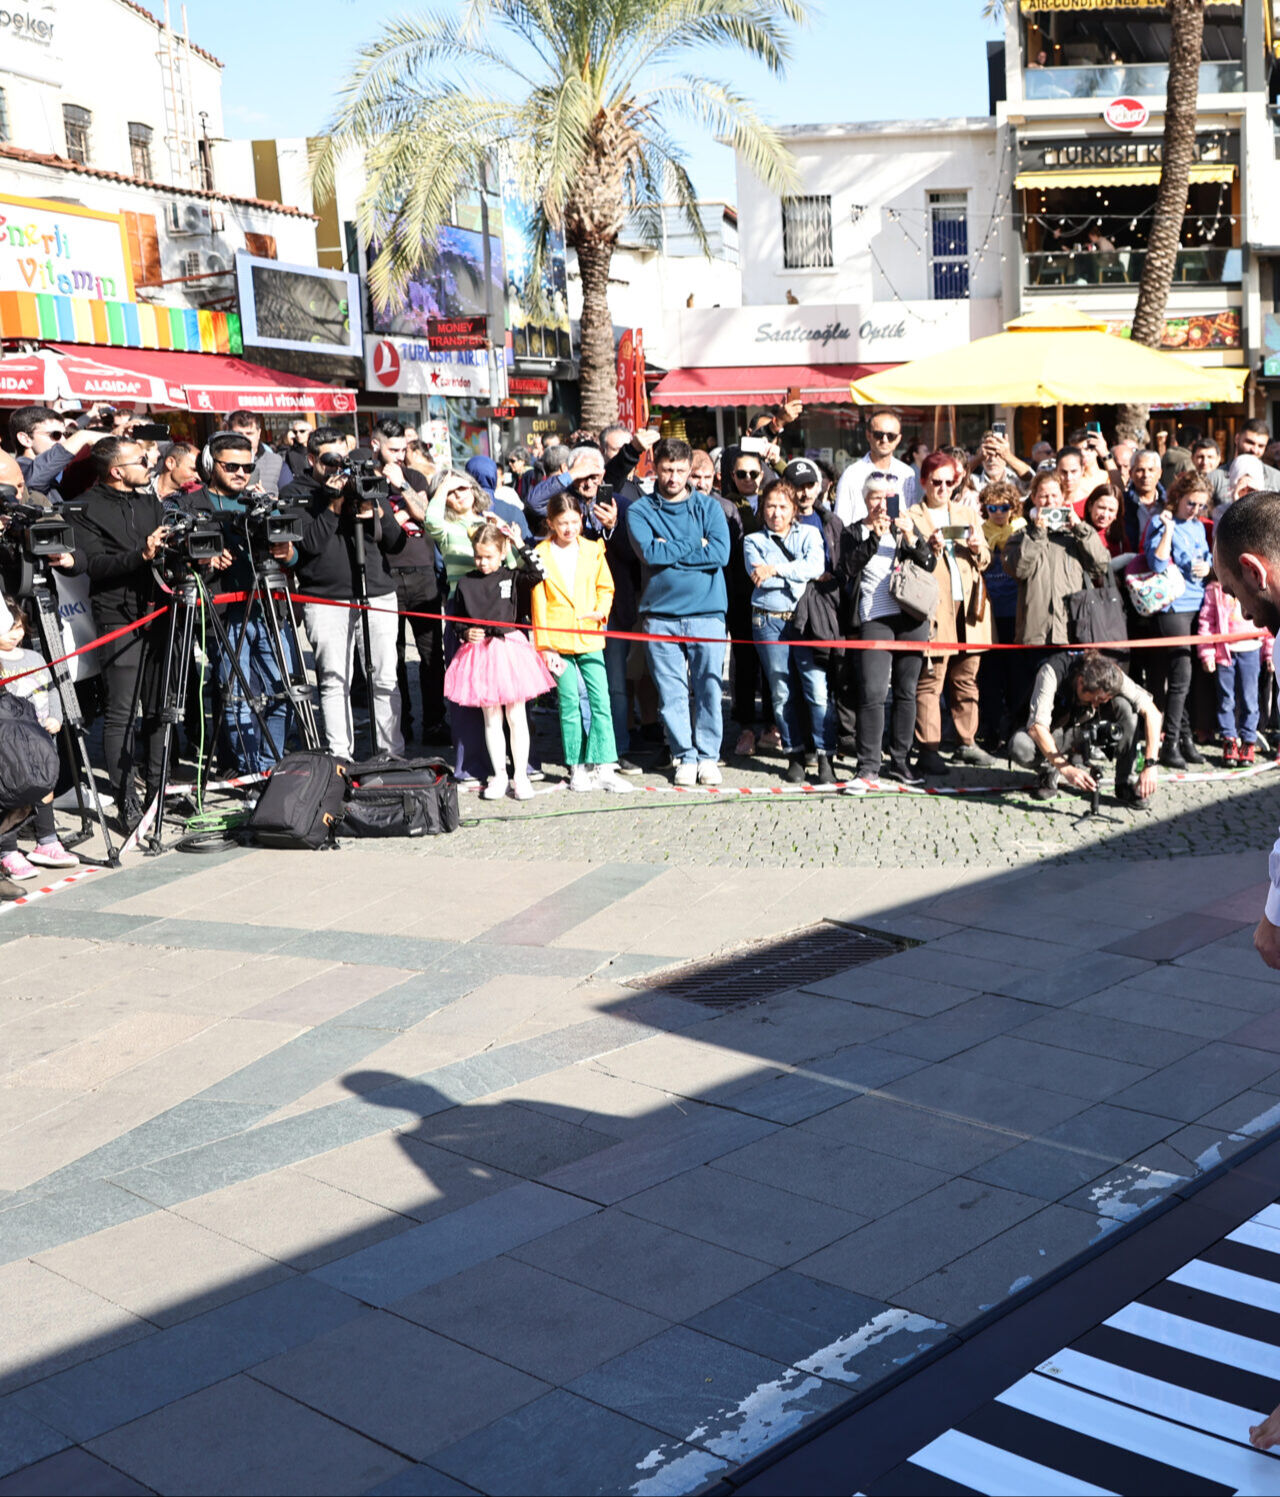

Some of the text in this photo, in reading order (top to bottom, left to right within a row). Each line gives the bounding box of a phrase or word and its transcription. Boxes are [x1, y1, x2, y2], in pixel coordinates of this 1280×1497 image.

[437, 322, 474, 334] MONEY
[858, 320, 907, 345] Optik
[430, 336, 483, 347] TRANSFER
[457, 349, 504, 369] AIRLIS
[532, 419, 557, 432] GOLD
